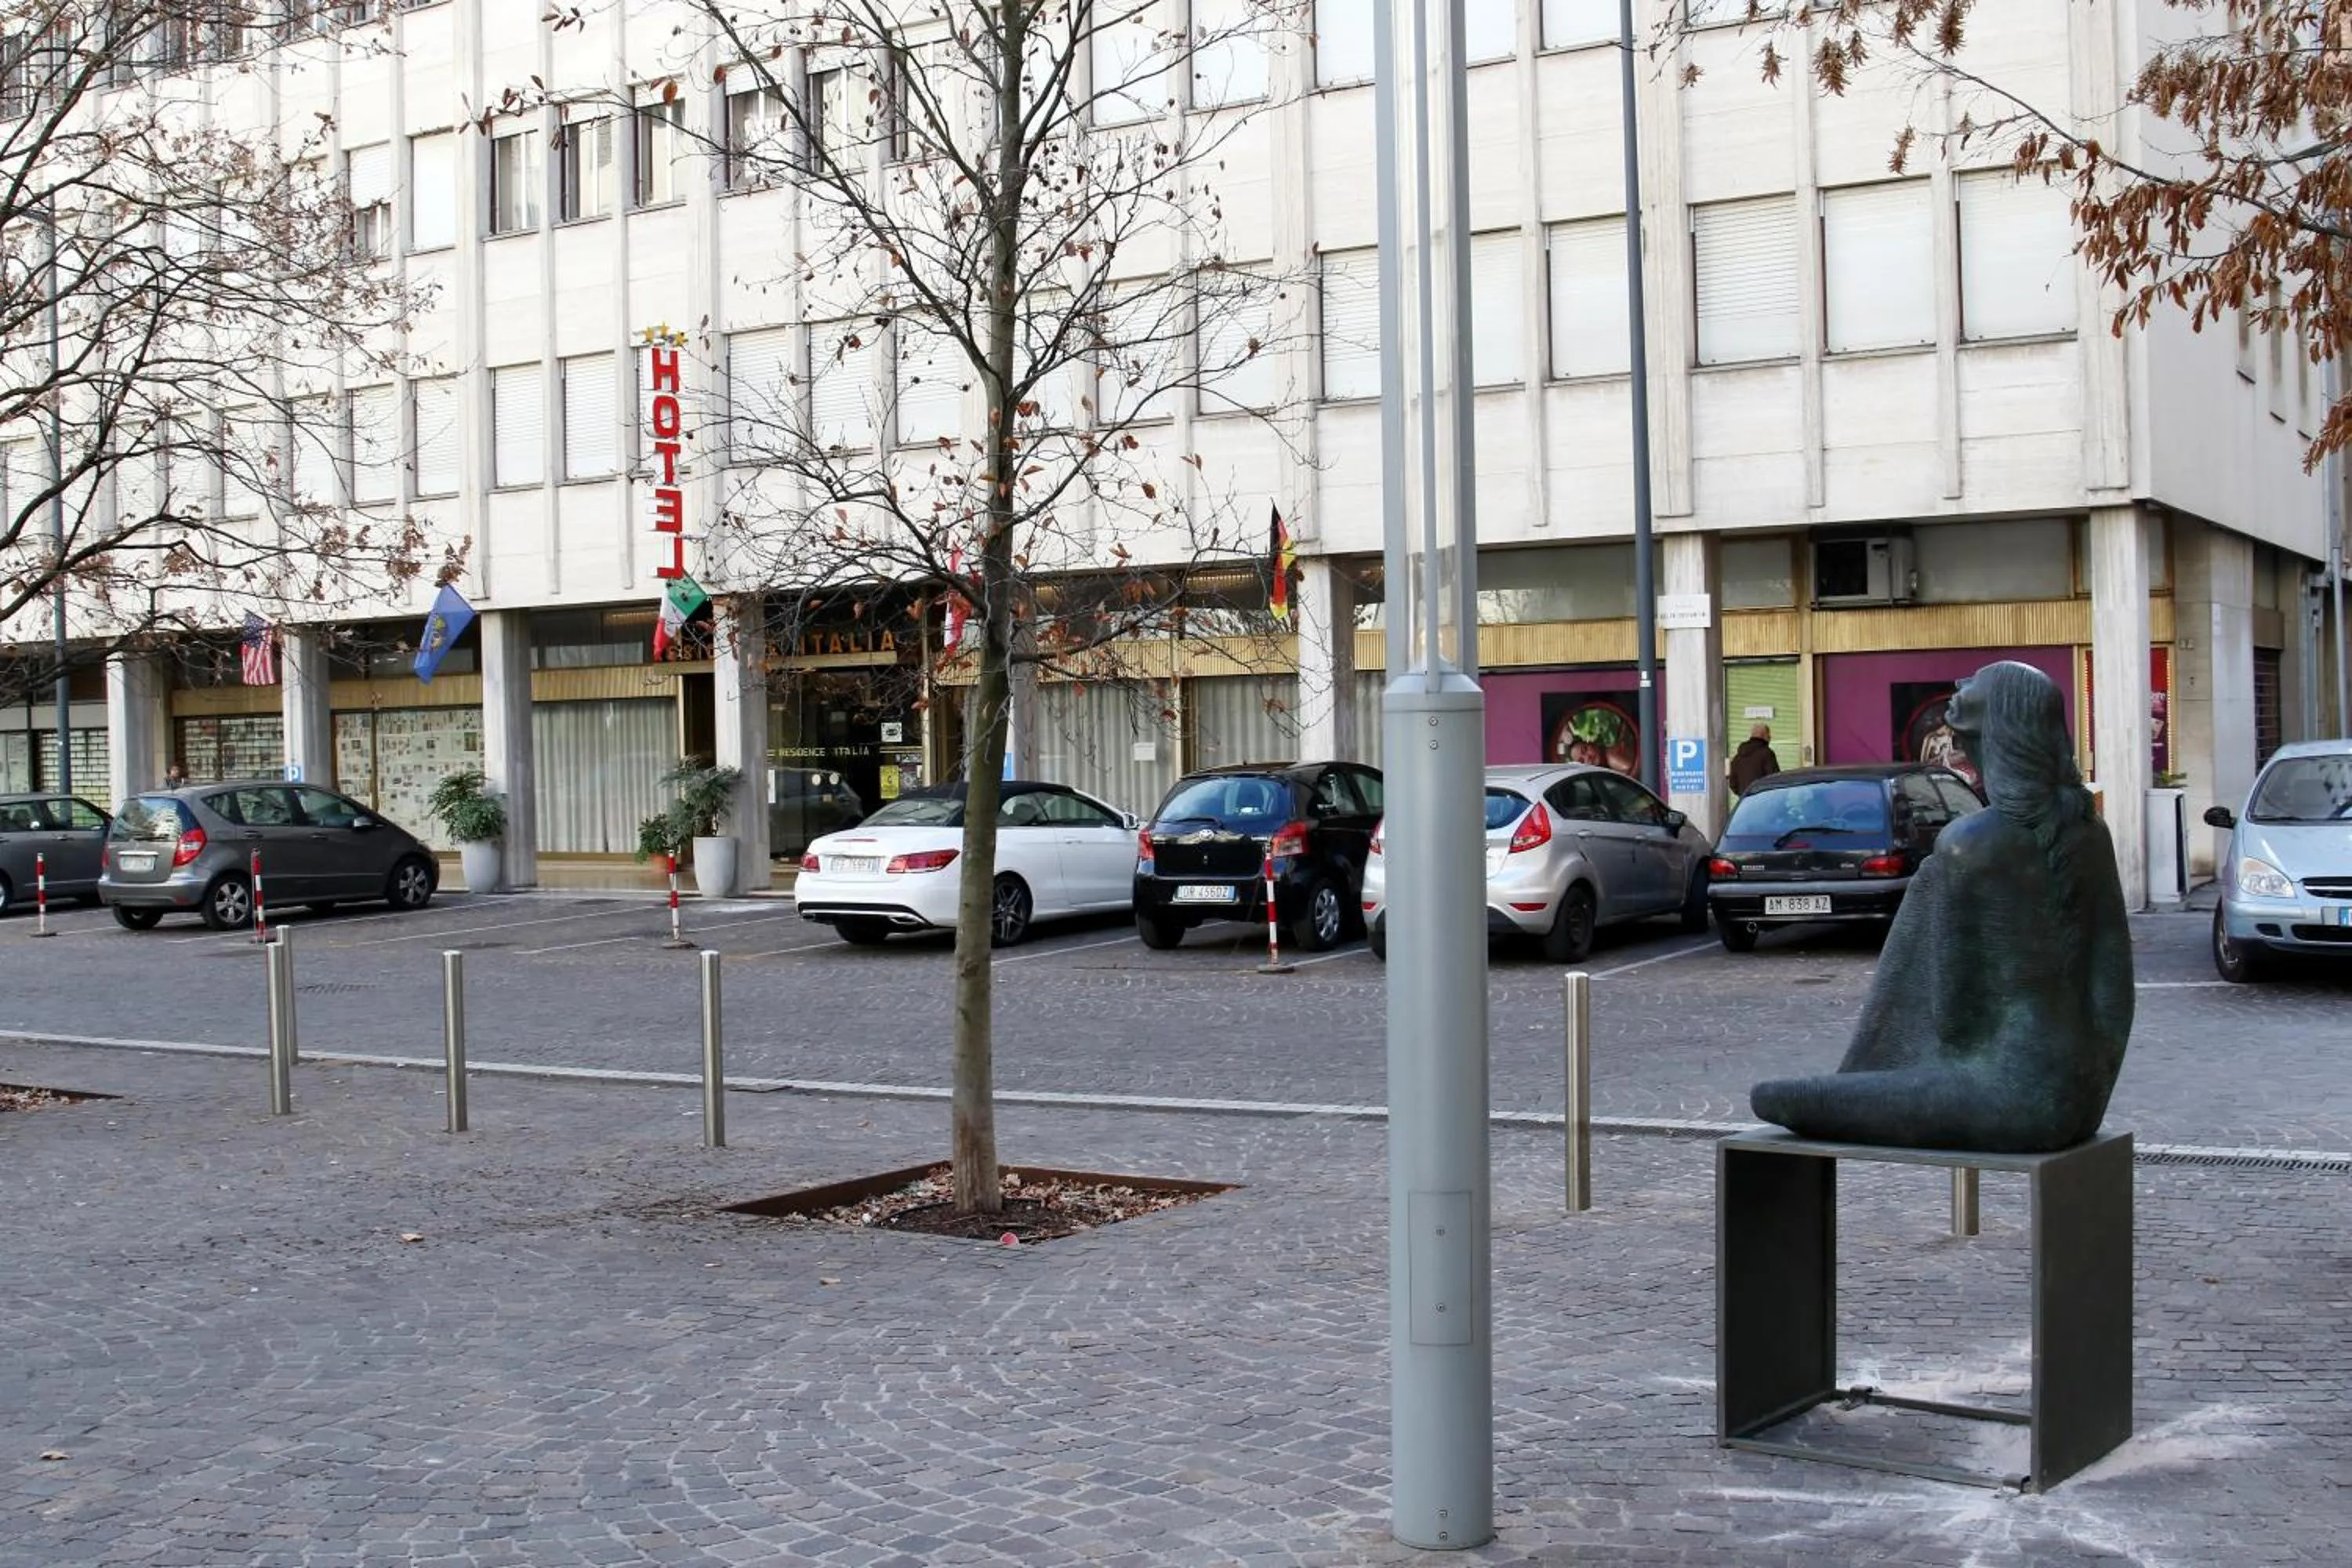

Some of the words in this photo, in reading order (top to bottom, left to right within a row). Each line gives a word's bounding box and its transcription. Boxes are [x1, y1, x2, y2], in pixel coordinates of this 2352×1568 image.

[799, 629, 895, 656] ITALIA
[779, 747, 826, 757] RESIDENCE
[834, 746, 869, 756] ITALIA
[1676, 741, 1697, 768] P
[289, 767, 299, 782] P
